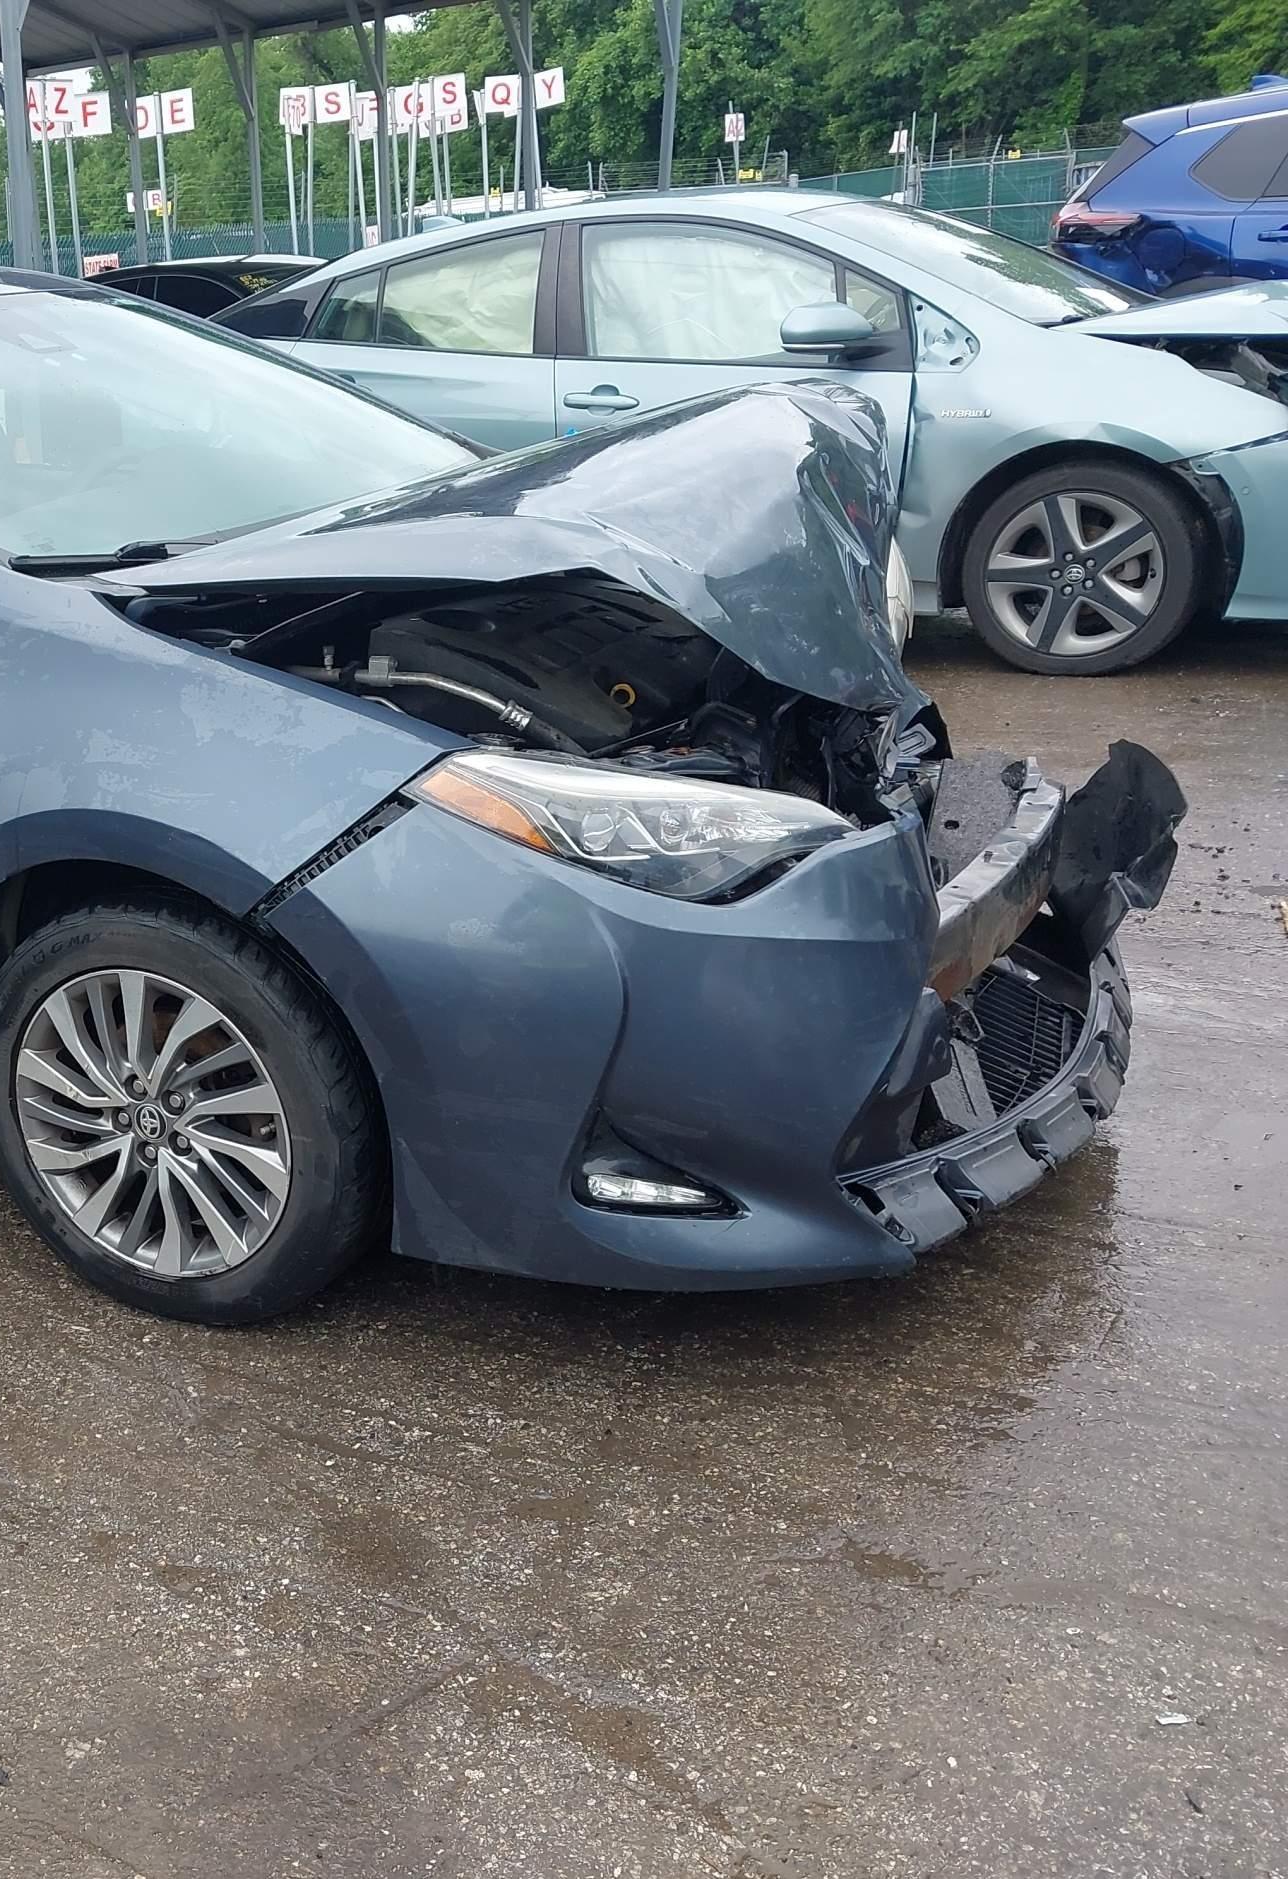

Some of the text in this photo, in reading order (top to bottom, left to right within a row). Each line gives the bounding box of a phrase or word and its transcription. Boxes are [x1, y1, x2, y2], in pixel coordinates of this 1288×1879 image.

[442, 81, 457, 105] S
[492, 82, 511, 106] Q
[542, 75, 556, 99] Y
[27, 87, 39, 114] A
[54, 87, 69, 114] Z
[170, 98, 186, 125] E
[324, 91, 341, 115] S
[81, 100, 98, 128] F
